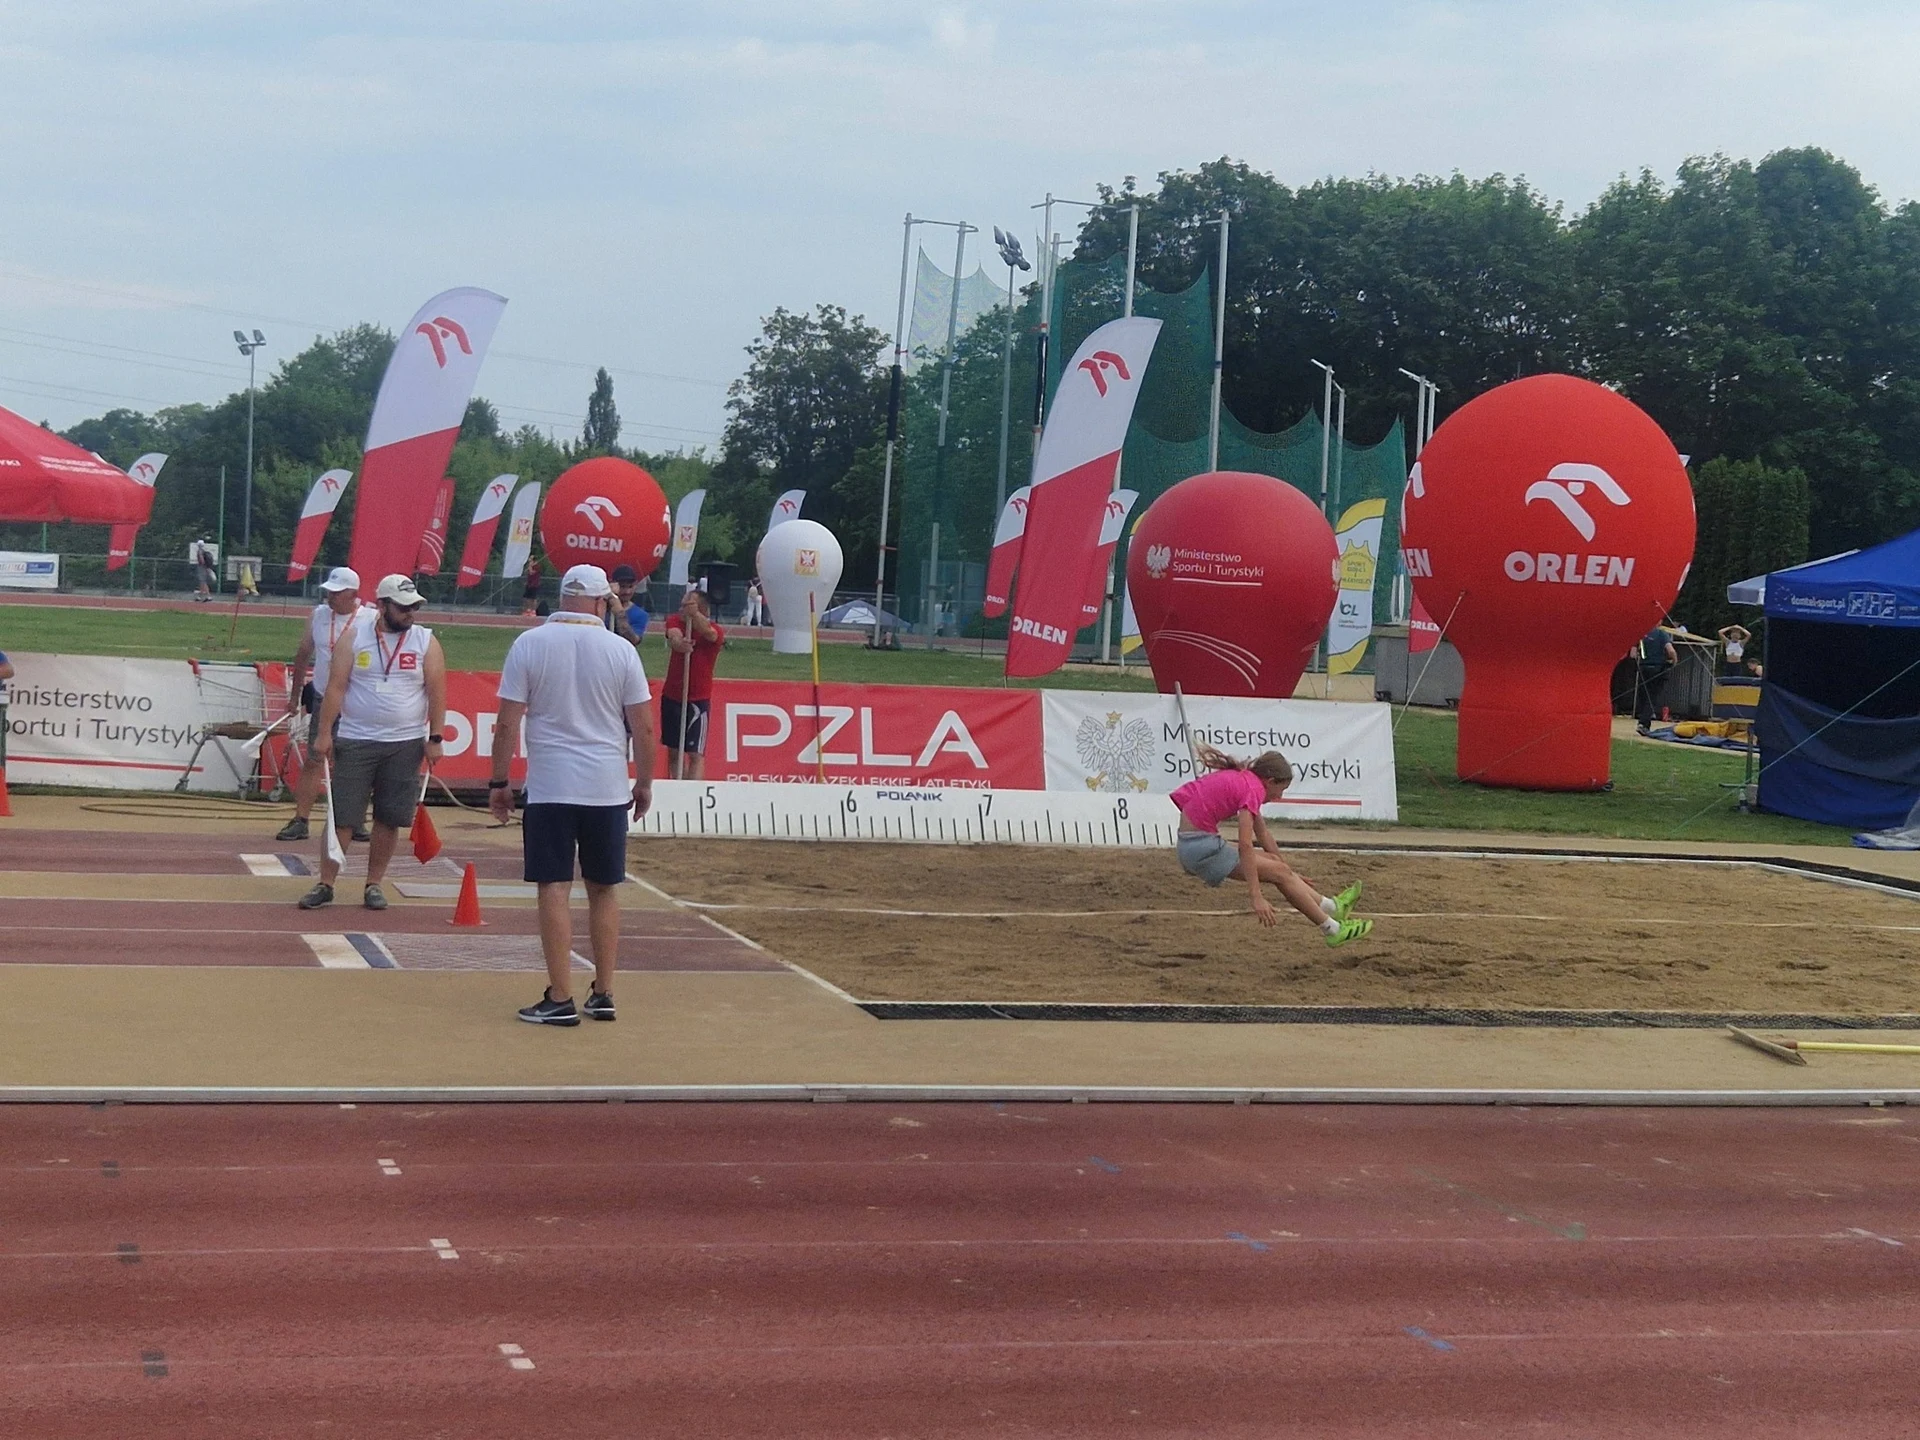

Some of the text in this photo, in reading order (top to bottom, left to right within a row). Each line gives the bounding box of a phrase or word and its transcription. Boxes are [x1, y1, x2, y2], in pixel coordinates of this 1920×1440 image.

[566, 533, 623, 553] ORLEN
[1174, 548, 1241, 563] Ministerstwo
[1401, 548, 1433, 577] LEN
[1173, 561, 1206, 574] Sportu
[1215, 564, 1264, 579] Turystyki
[1504, 551, 1635, 587] ORLEN
[1082, 604, 1098, 614] LEN
[9, 683, 153, 713] inisterstwo
[76, 717, 82, 738] i
[726, 703, 989, 770] PZLA
[1163, 722, 1312, 748] Mnisterstwo
[705, 786, 1129, 820] 5 6 7 8
[876, 790, 943, 802] POLANIK
